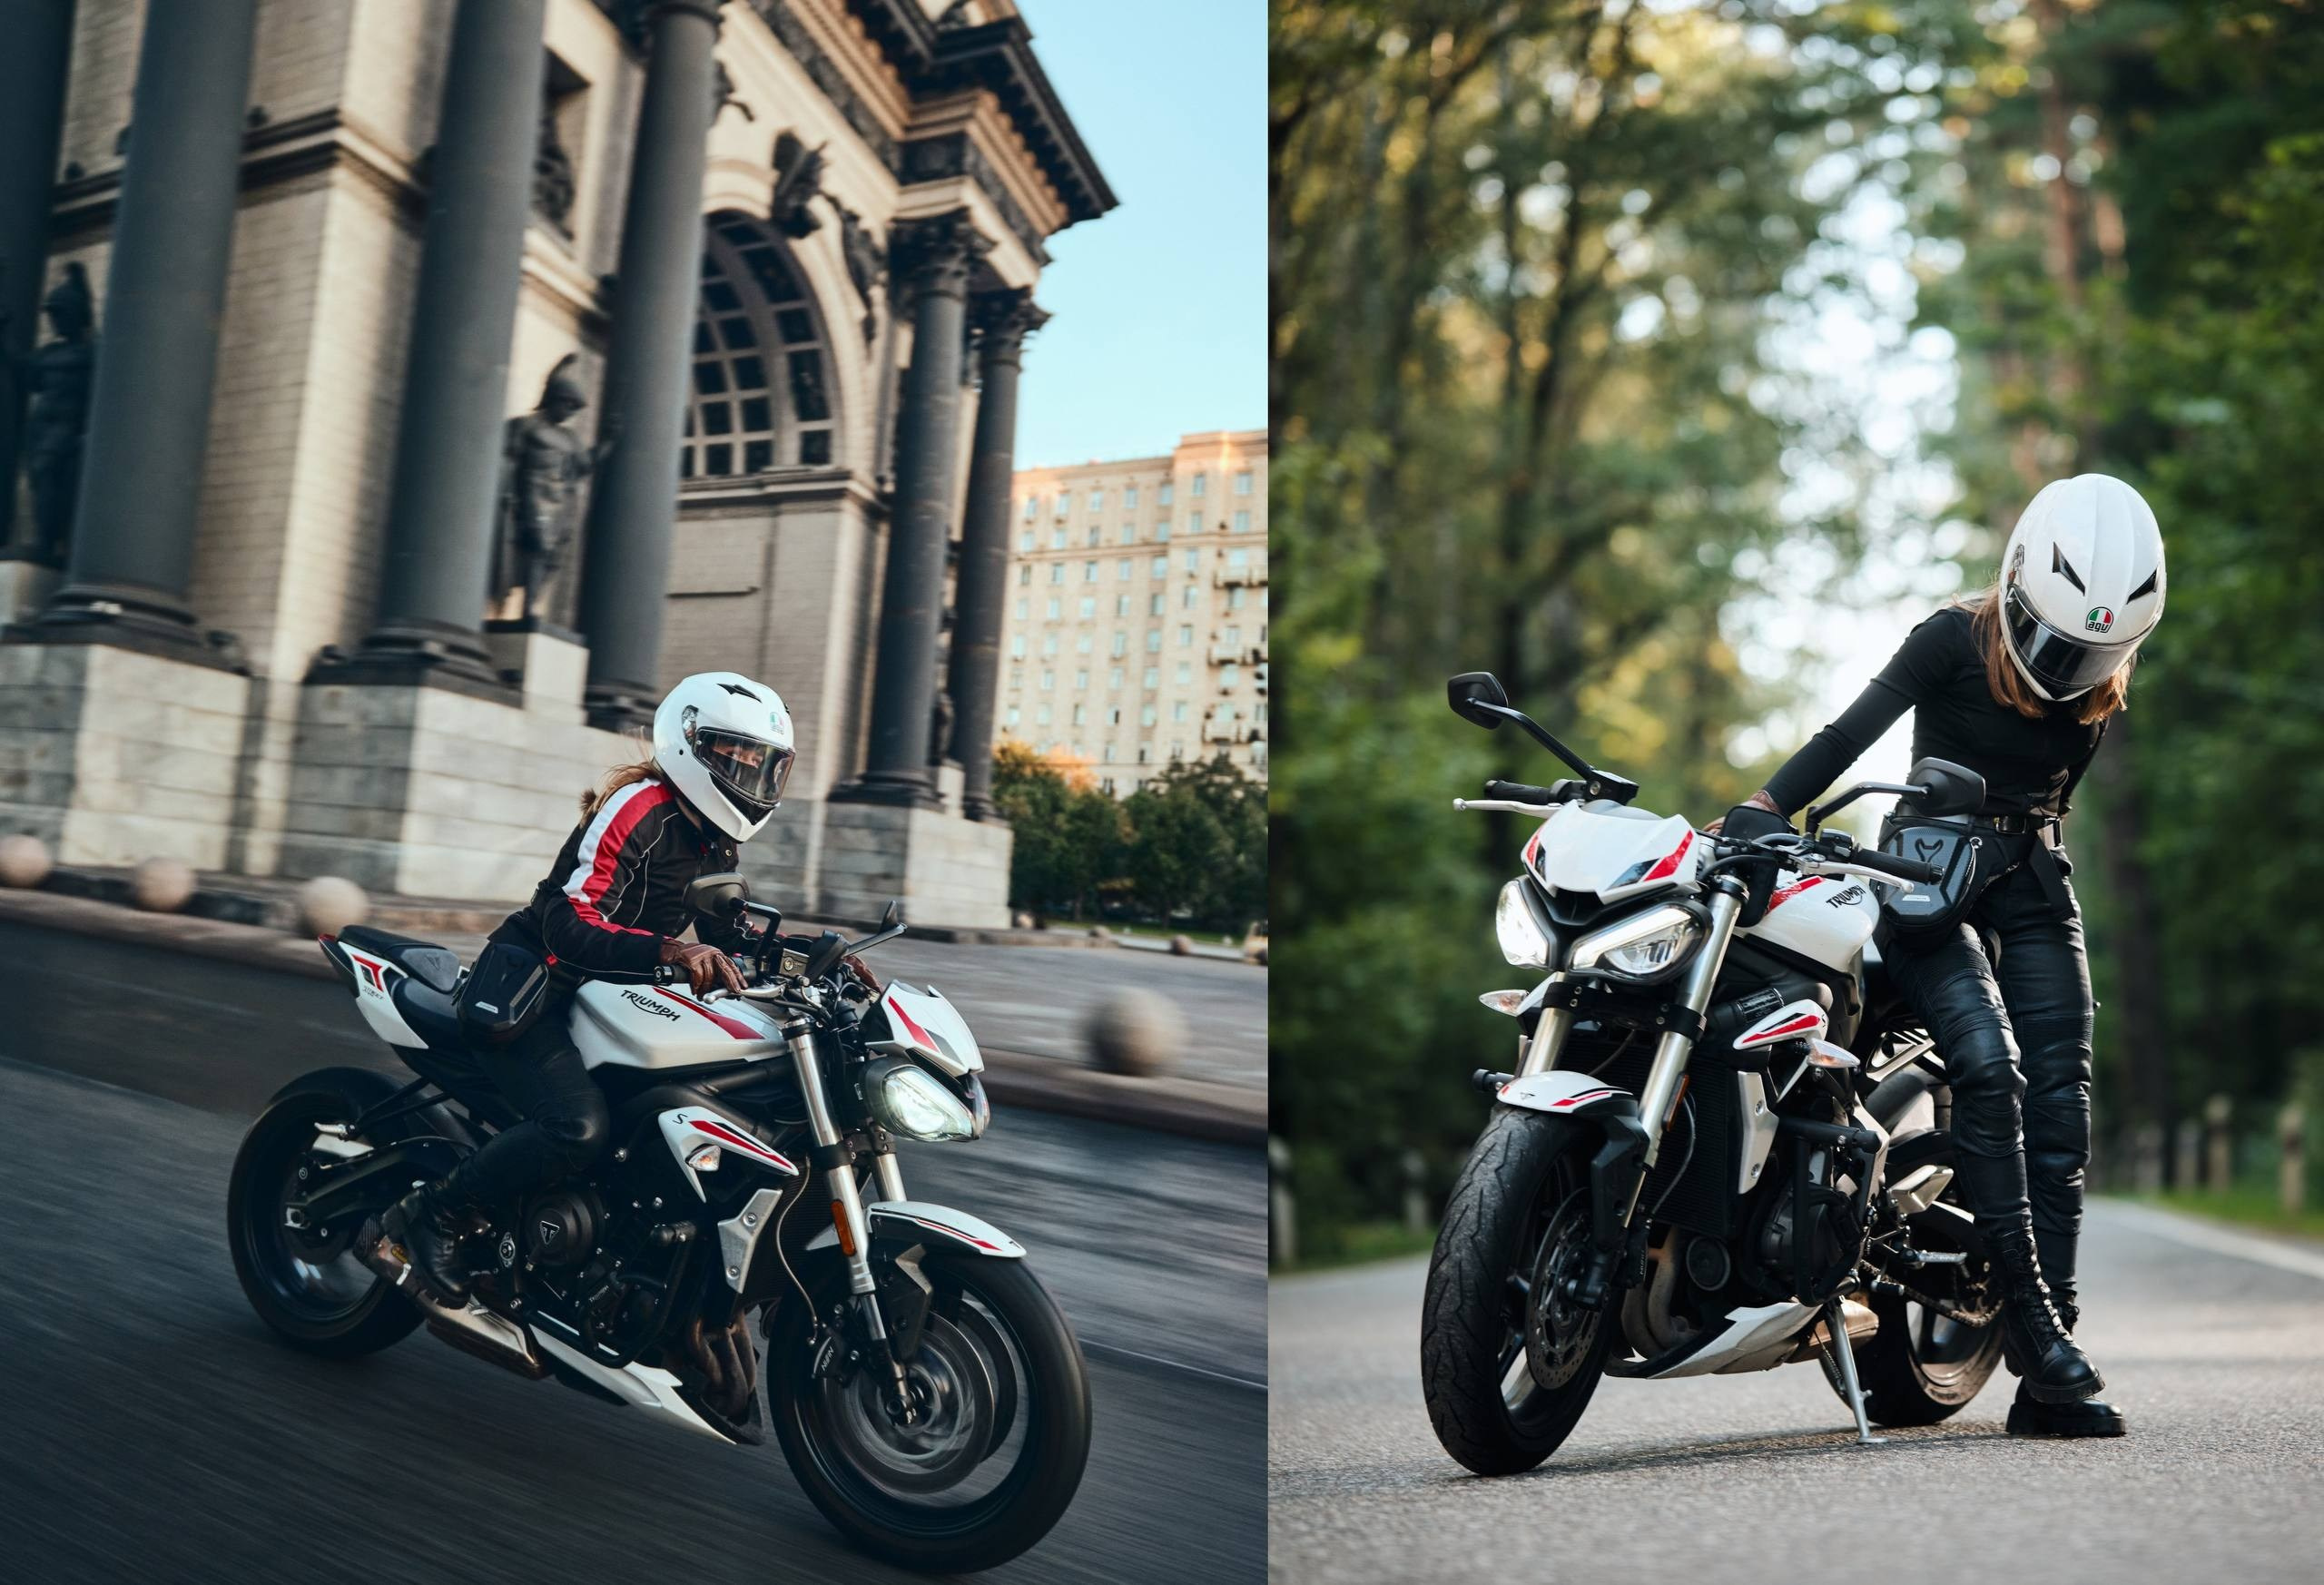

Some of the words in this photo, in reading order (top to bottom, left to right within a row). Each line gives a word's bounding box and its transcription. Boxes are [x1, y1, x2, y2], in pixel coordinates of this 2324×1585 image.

[2088, 621, 2109, 633] agv
[1826, 884, 1866, 909] TRIUMPH
[620, 989, 681, 1022] TRIUMPH
[672, 1113, 688, 1125] S
